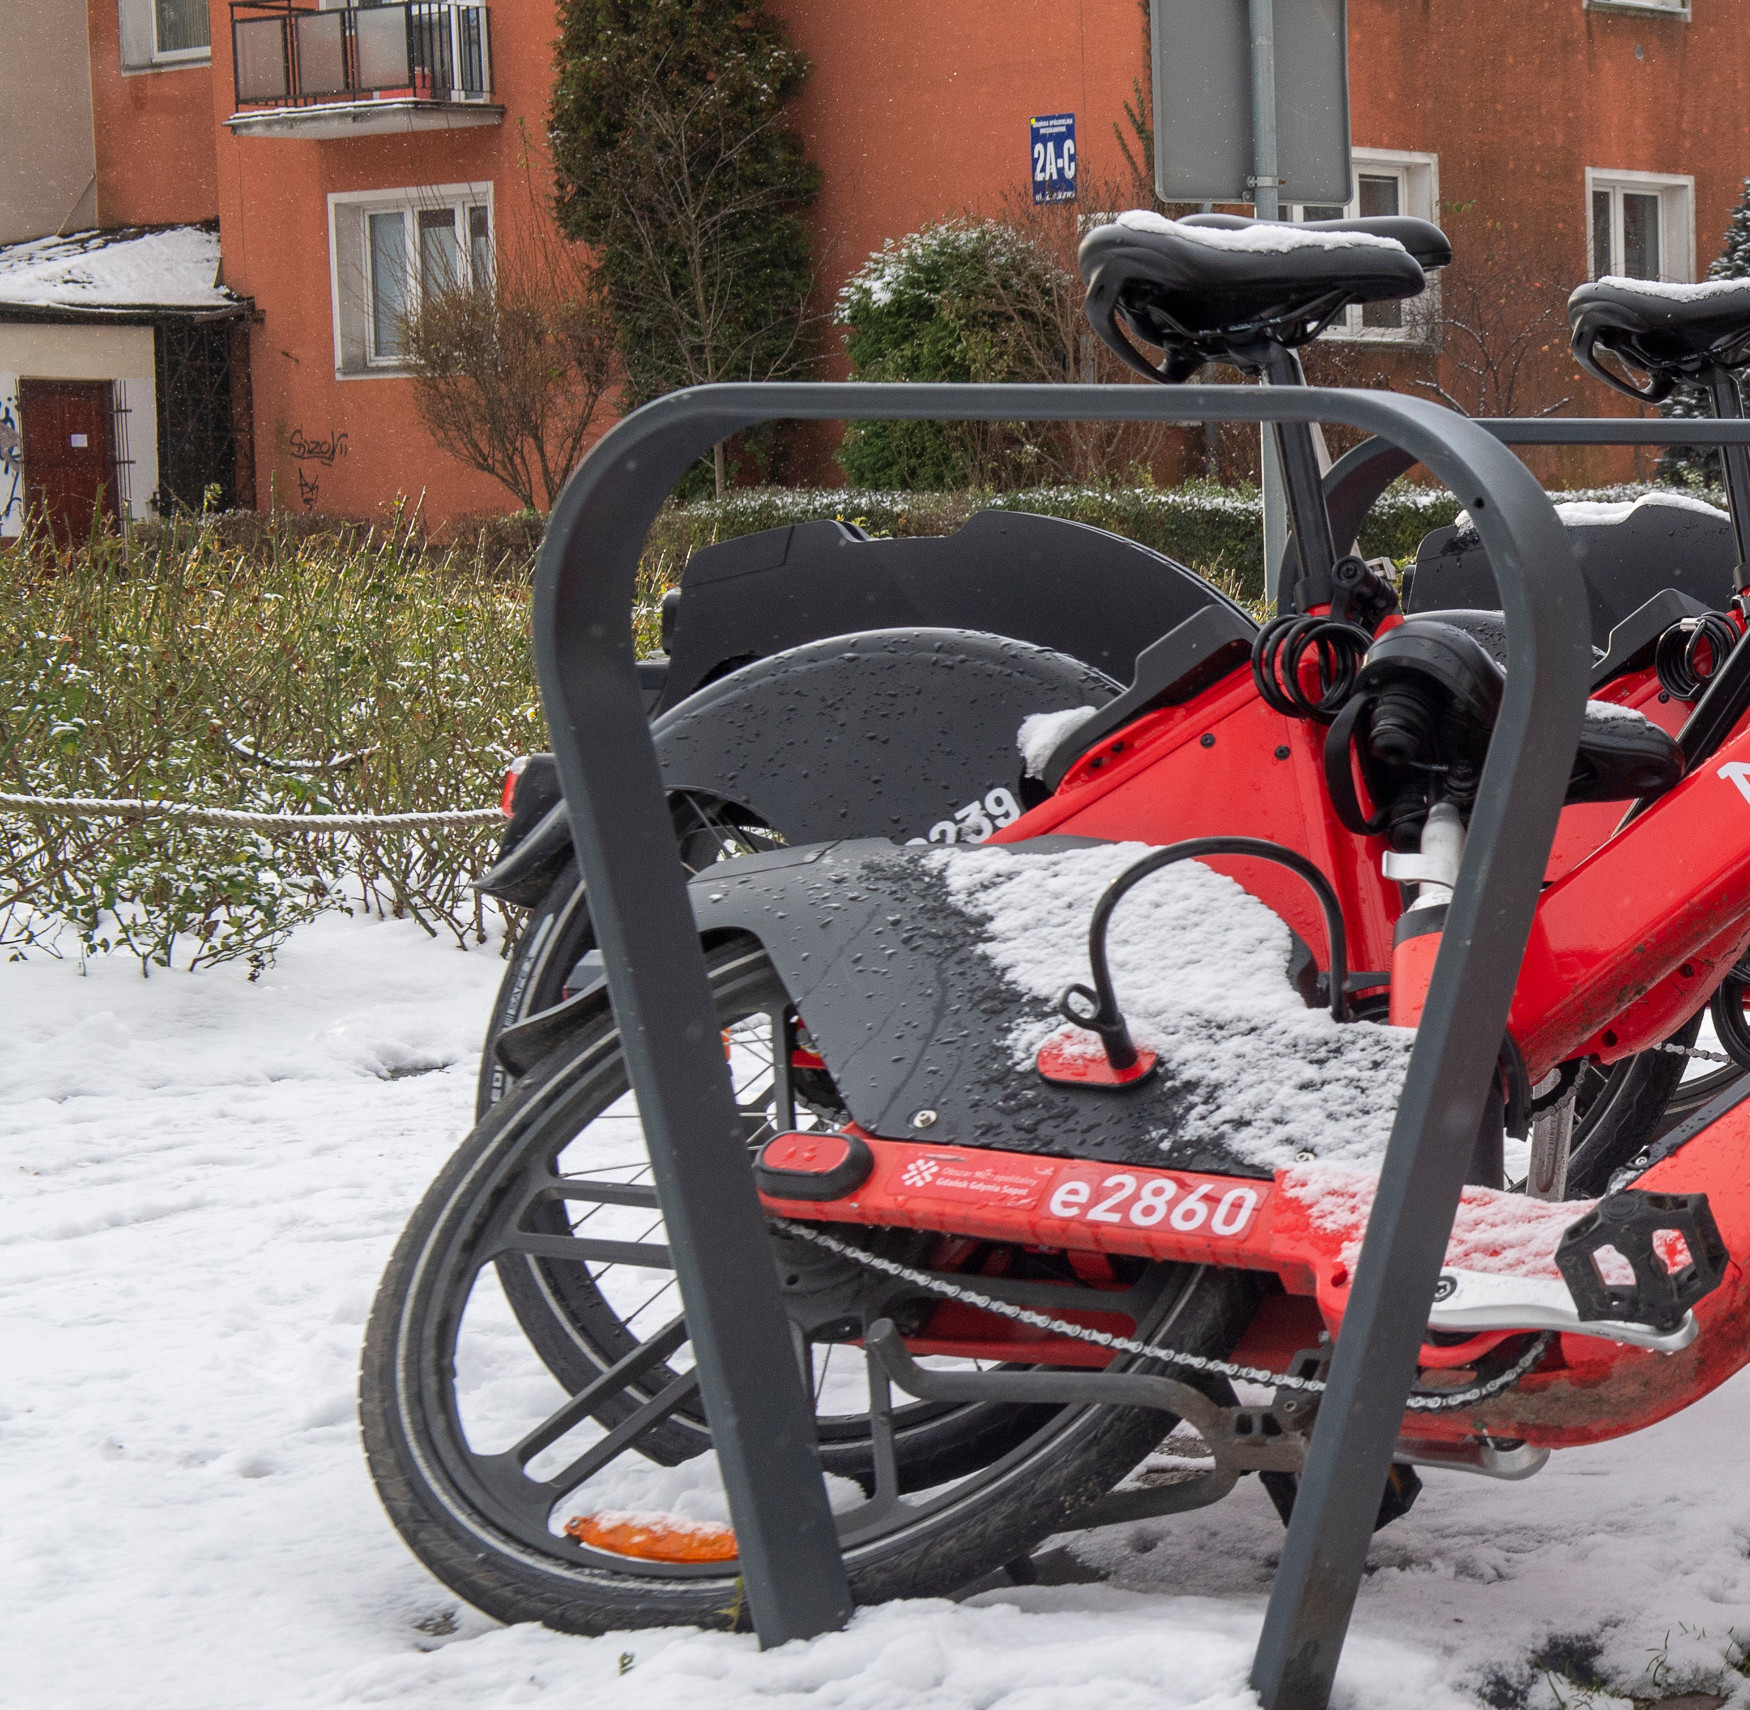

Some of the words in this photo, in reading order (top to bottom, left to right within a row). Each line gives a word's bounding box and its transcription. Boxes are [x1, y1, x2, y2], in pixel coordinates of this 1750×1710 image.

[1033, 139, 1076, 181] 2A-C
[904, 787, 1021, 846] 239
[1049, 1174, 1258, 1236] e2860
